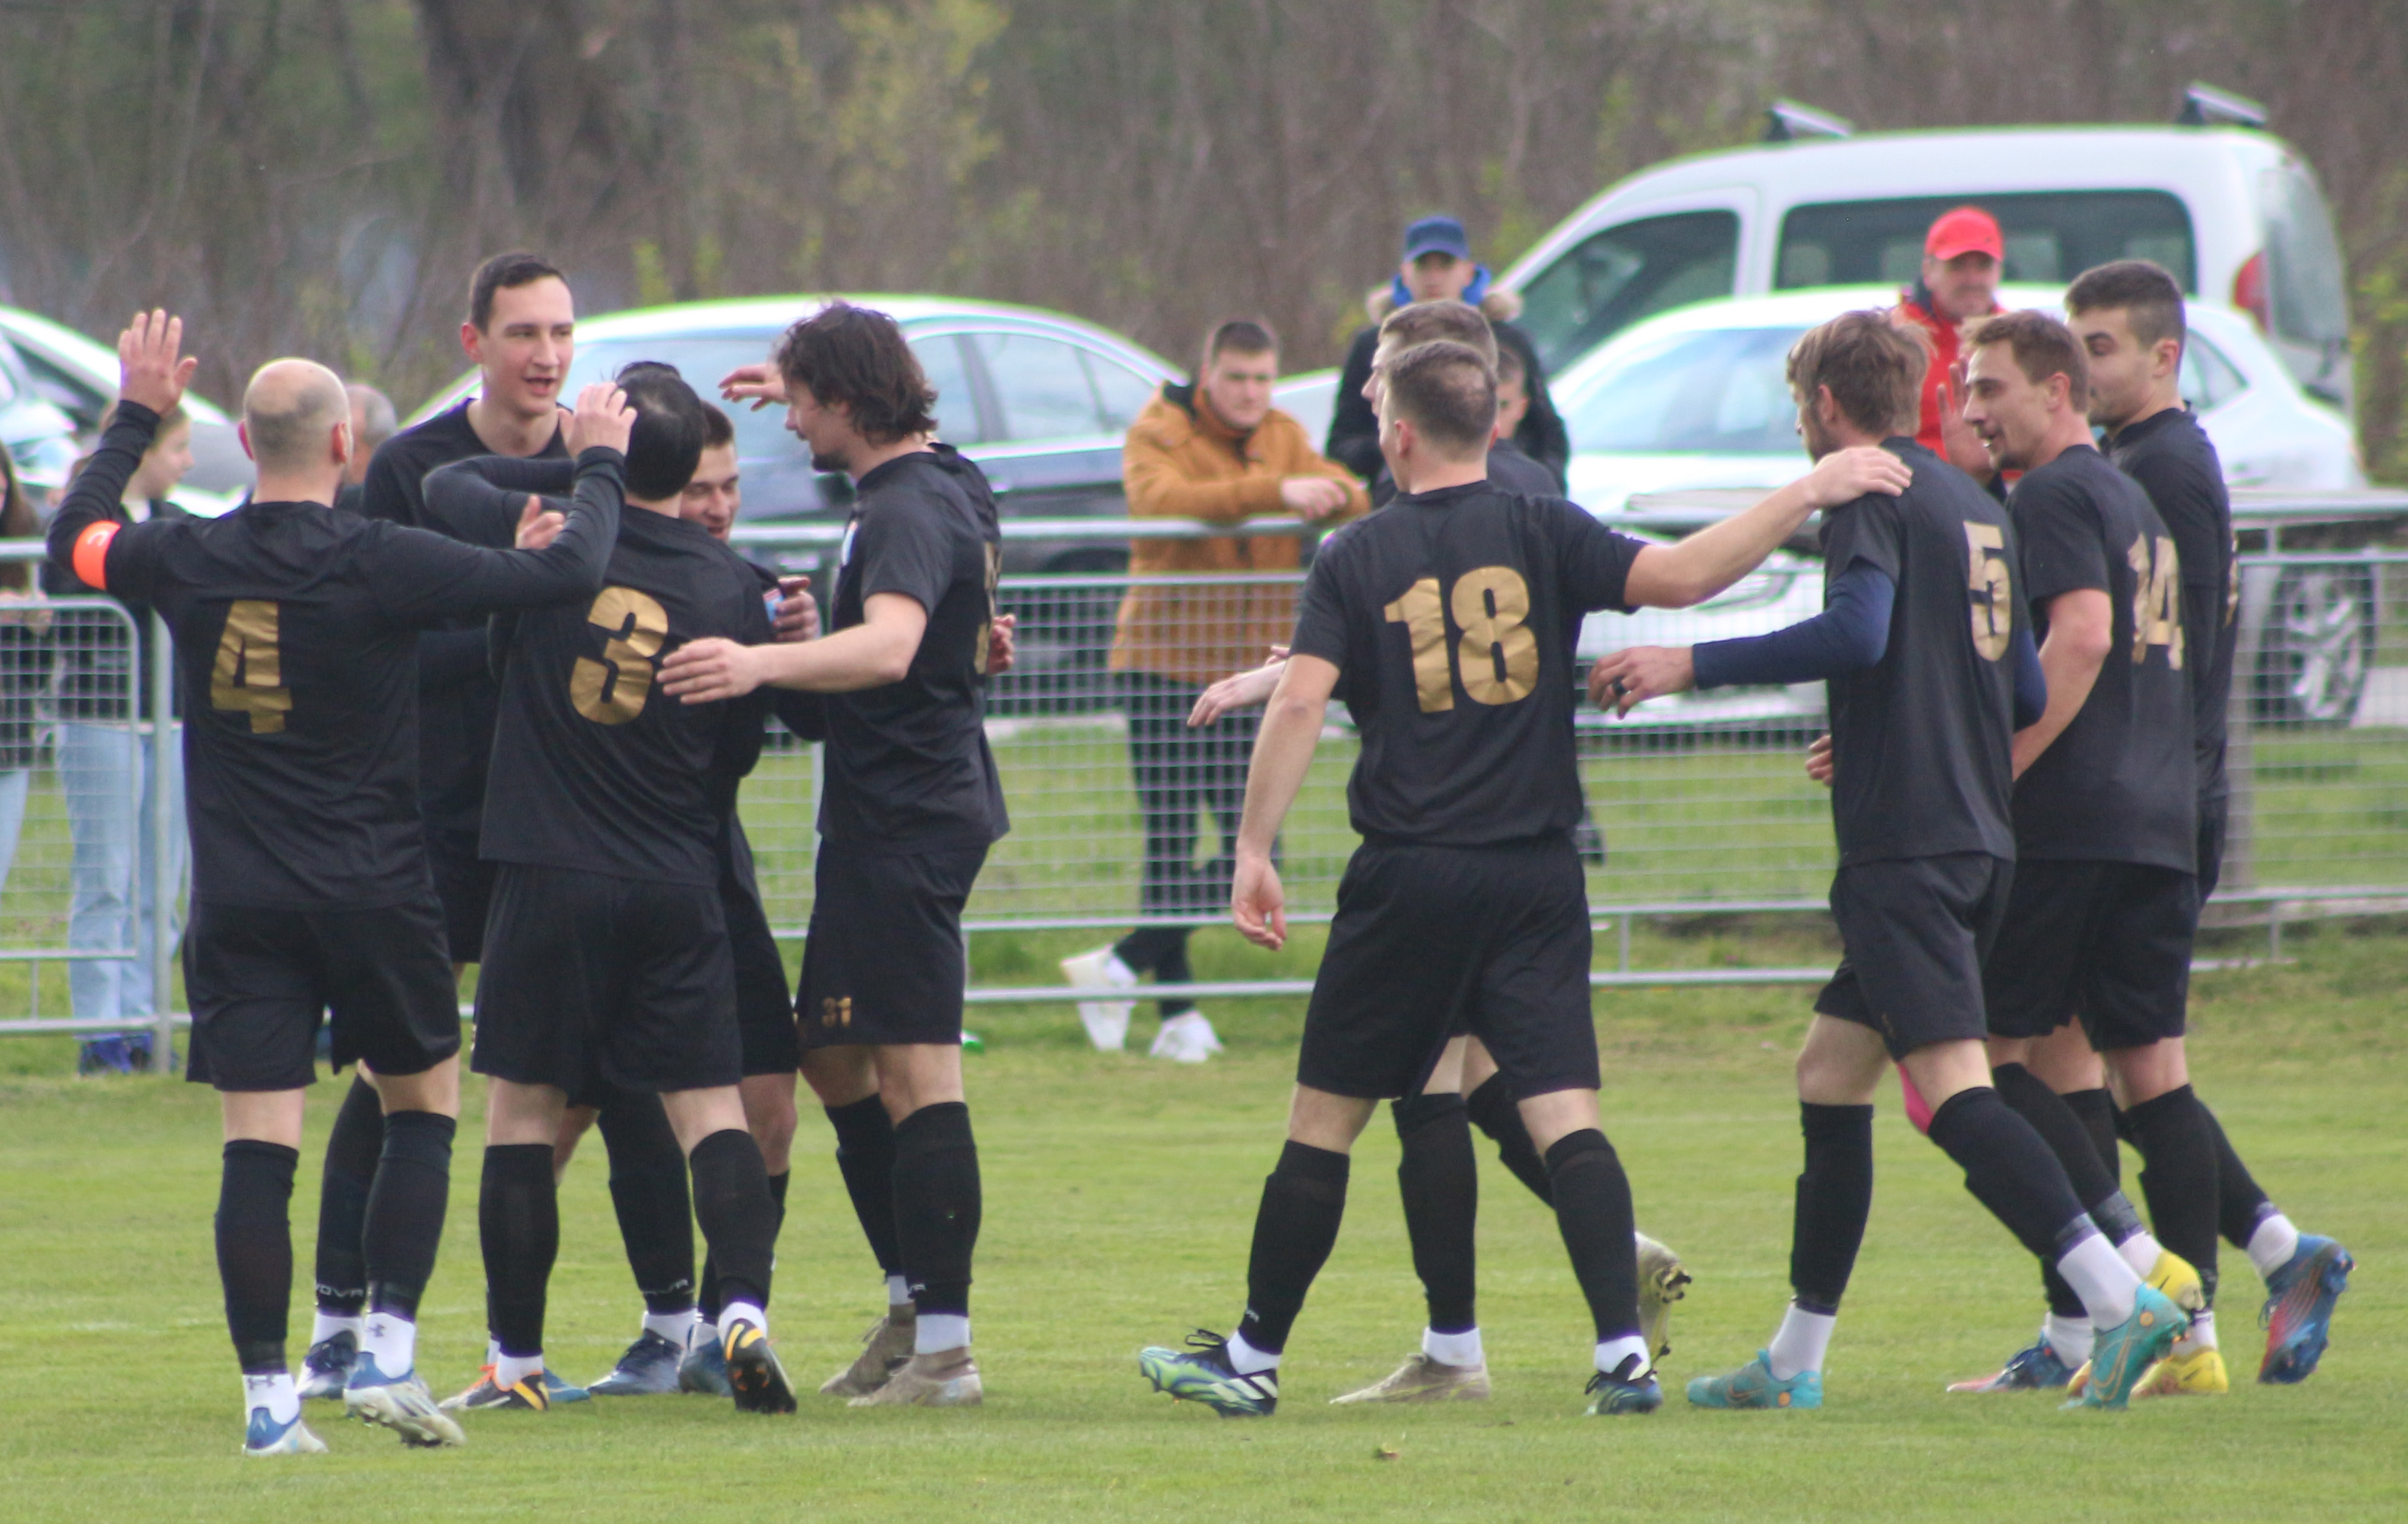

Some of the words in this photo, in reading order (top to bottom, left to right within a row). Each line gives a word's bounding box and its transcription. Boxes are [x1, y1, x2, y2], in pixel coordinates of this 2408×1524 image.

[569, 585, 669, 725] 3
[1384, 565, 1540, 713] 18
[1963, 521, 2012, 662] 5
[2127, 532, 2185, 670] 14
[210, 599, 293, 734] 4
[822, 996, 852, 1027] 31
